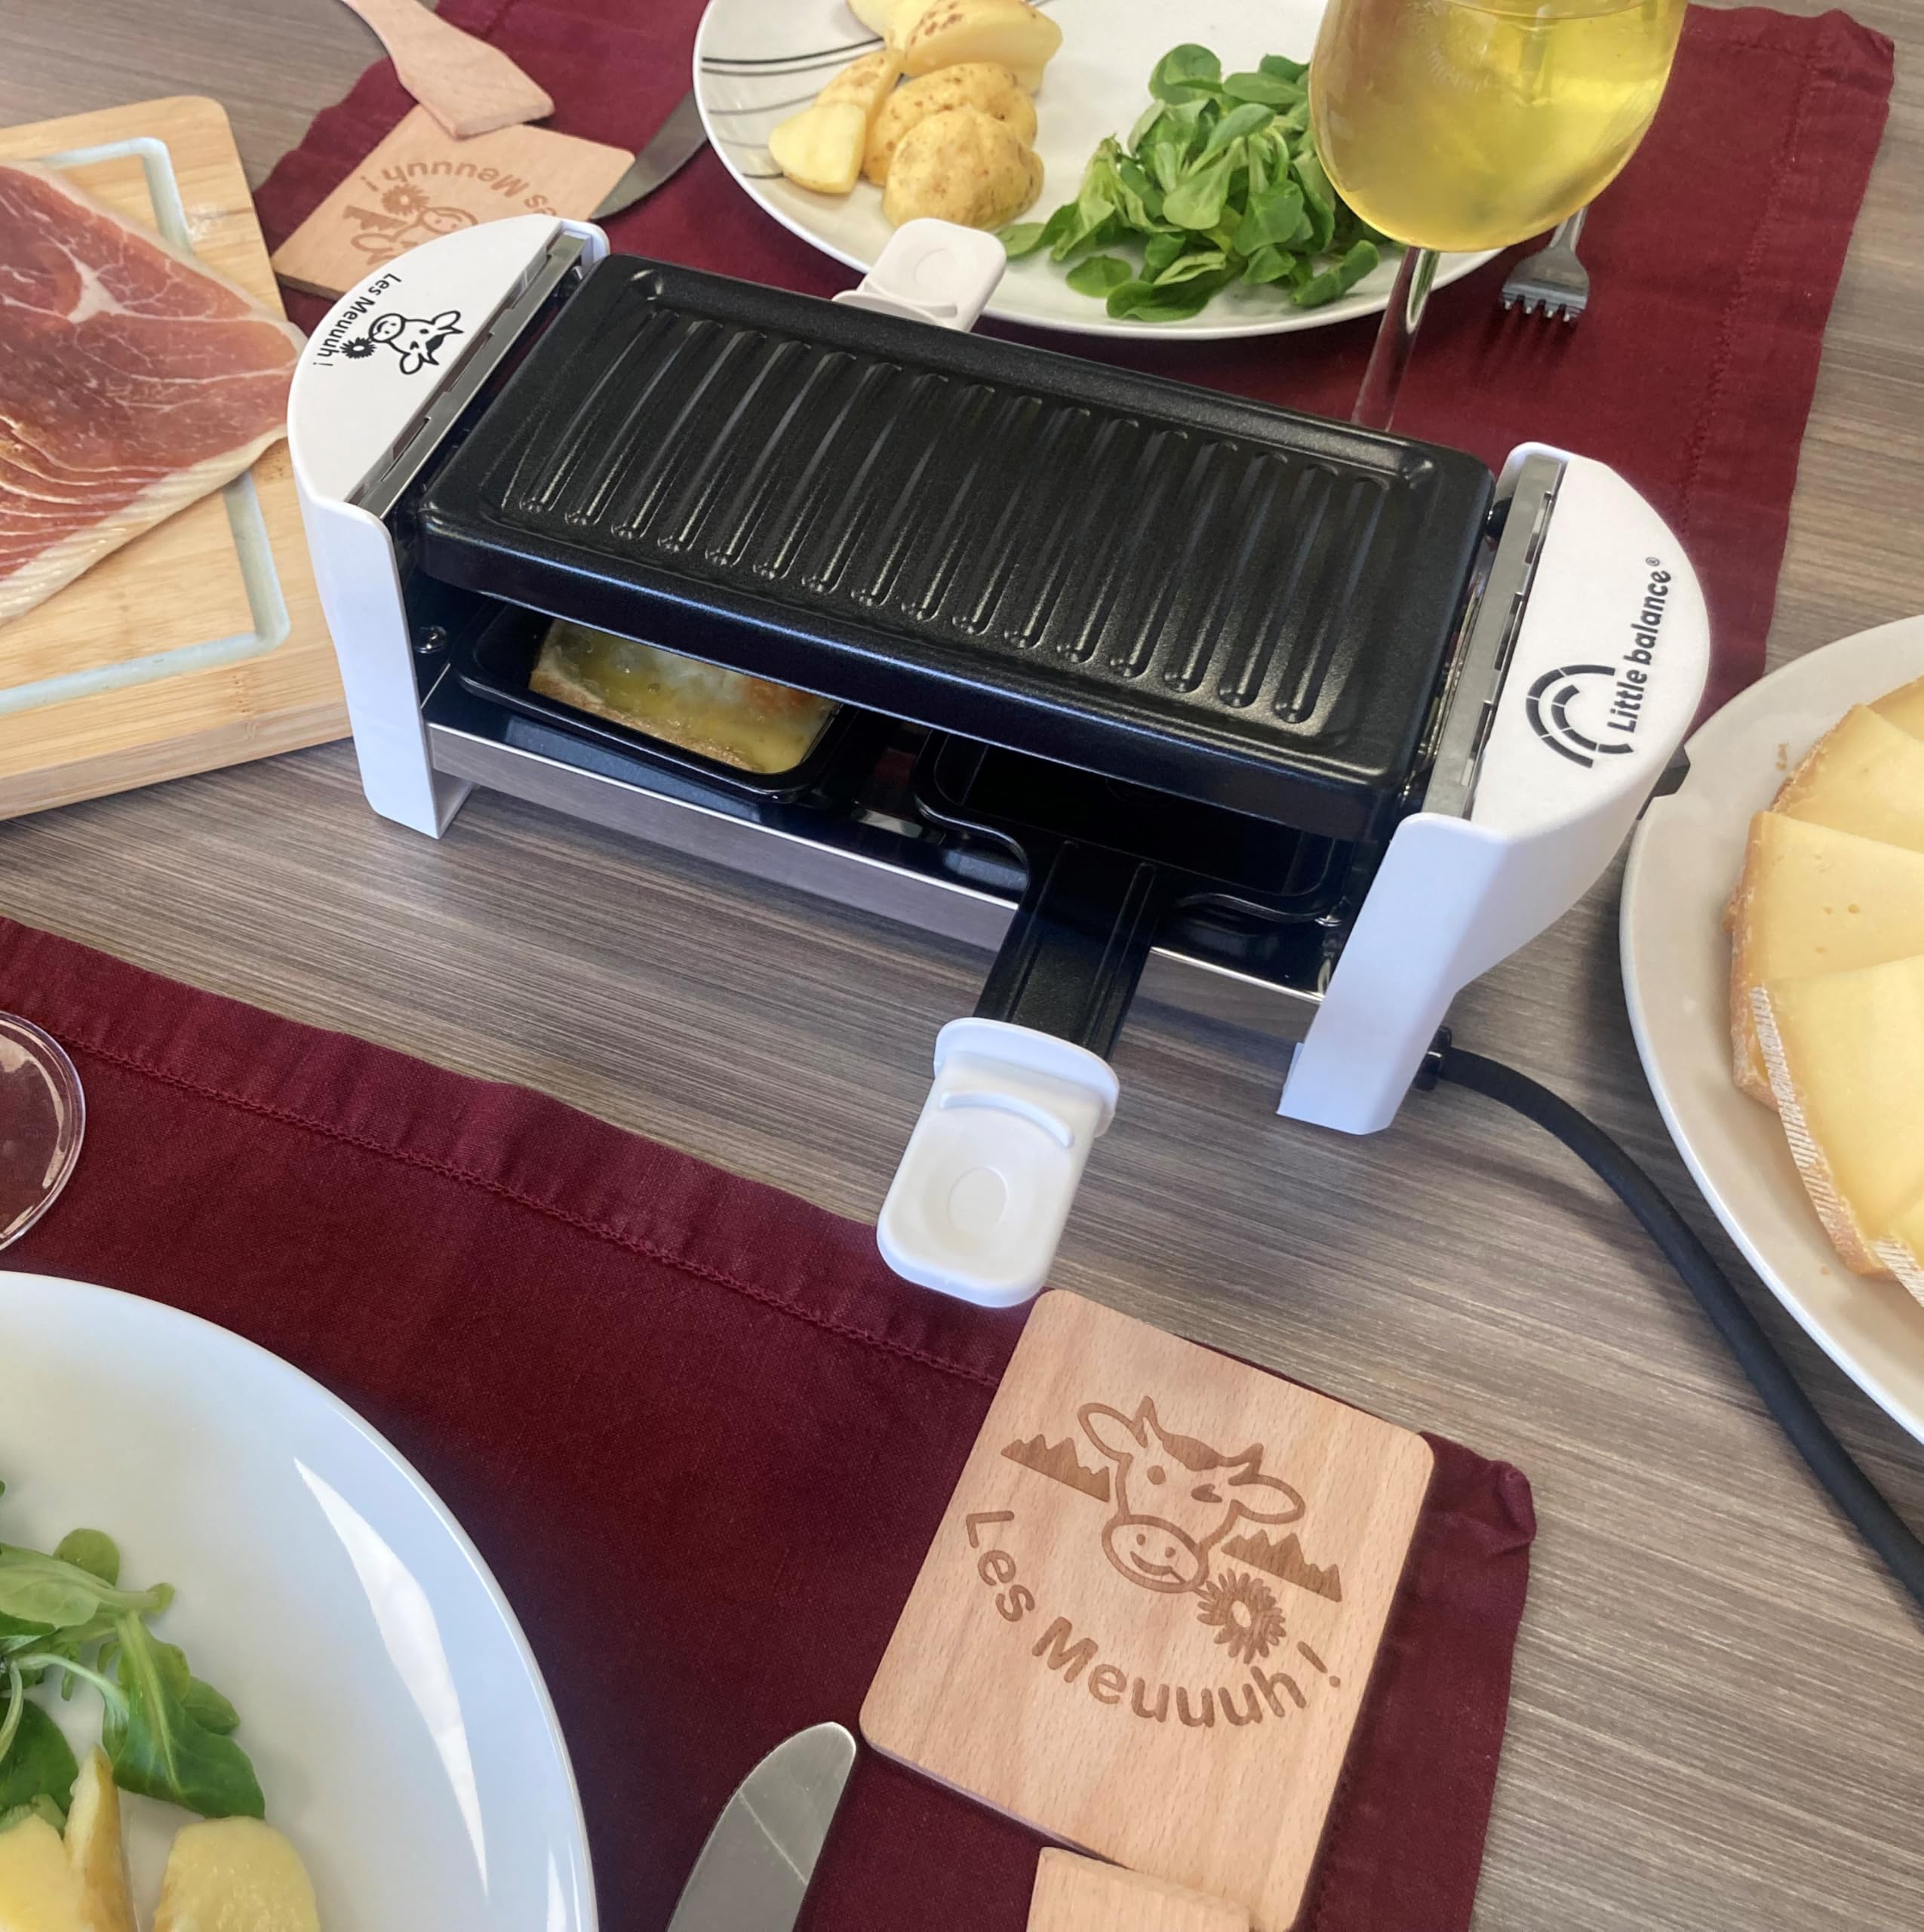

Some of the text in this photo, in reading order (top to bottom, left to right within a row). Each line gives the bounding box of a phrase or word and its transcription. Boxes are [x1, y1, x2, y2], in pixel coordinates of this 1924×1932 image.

[368, 273, 402, 296] Les
[1607, 669, 1647, 733] Little
[966, 1510, 1035, 1622] Les
